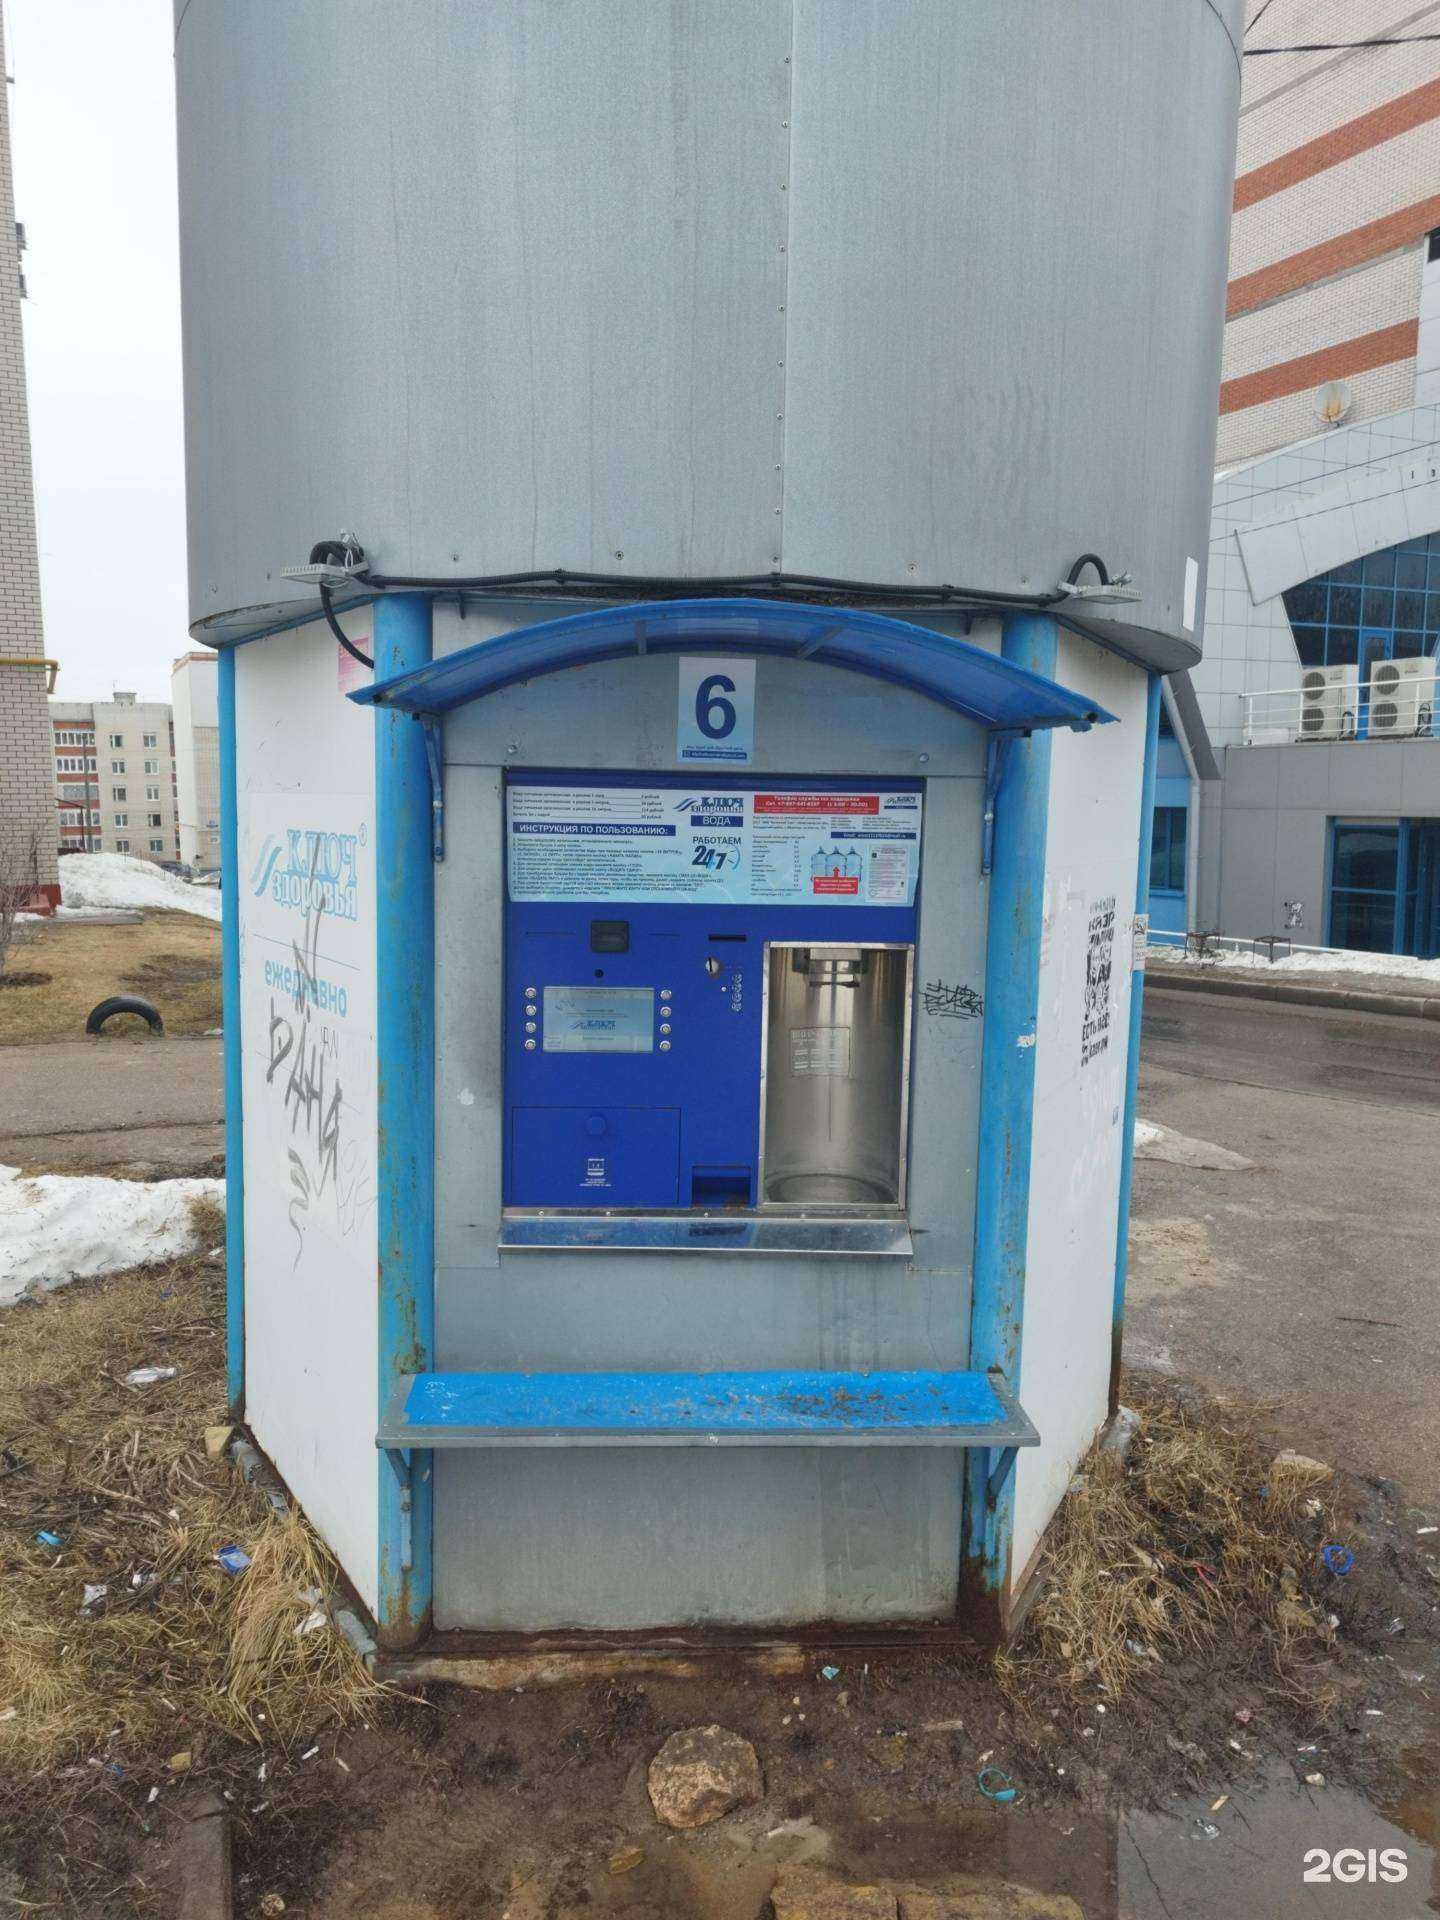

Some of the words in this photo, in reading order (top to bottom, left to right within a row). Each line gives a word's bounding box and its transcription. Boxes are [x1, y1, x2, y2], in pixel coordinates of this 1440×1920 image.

[695, 674, 737, 740] 6
[702, 816, 731, 826] ВОДА
[519, 824, 578, 834] ИНСТРУКЦИЯ
[580, 825, 593, 834] ПО
[596, 825, 669, 835] ПОЛЬЗОВАНИЮ:
[692, 836, 742, 846] РАБОТАЕМ
[287, 828, 358, 888] КЛЮЧ
